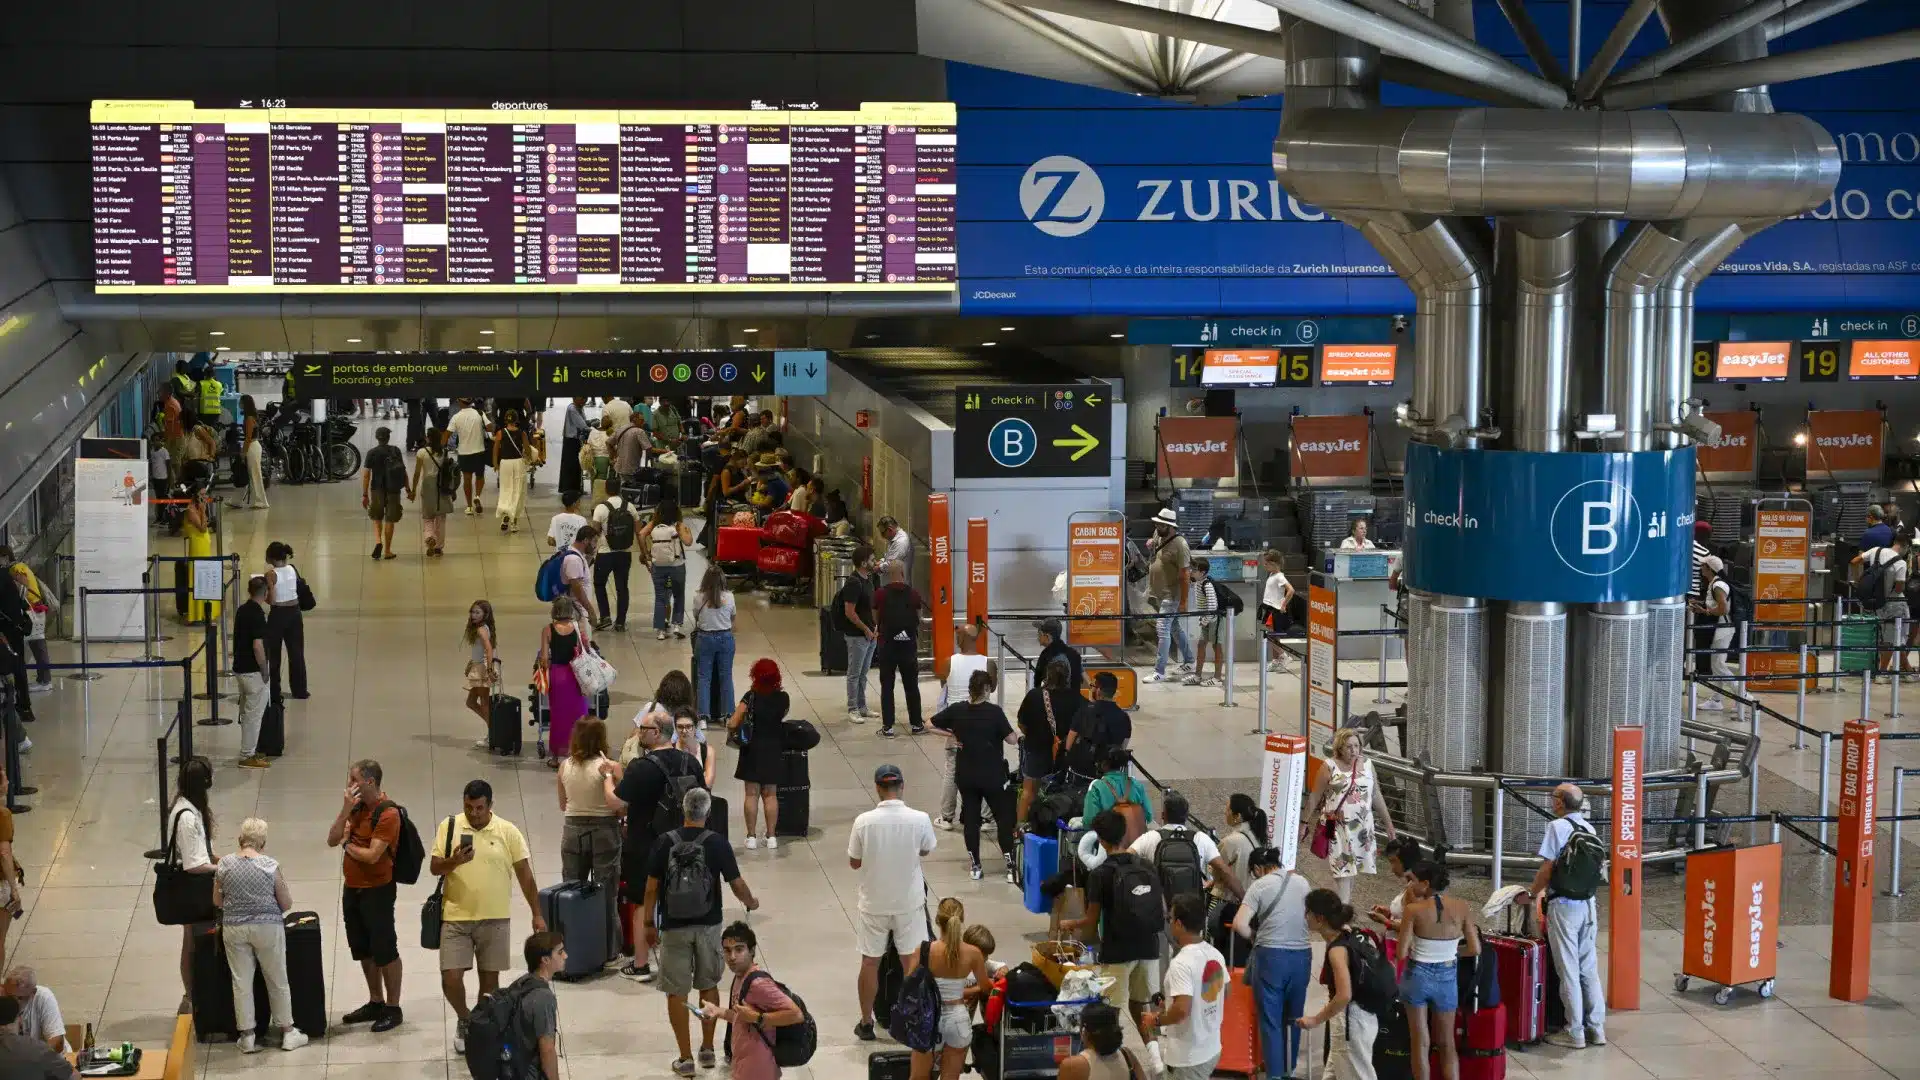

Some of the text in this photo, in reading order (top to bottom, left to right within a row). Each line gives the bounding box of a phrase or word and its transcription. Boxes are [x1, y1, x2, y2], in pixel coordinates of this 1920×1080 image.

[261, 99, 286, 108] 16:23
[492, 101, 548, 110] departures
[1136, 179, 1338, 221] ZURIC
[1024, 264, 1048, 275] Esta
[1050, 264, 1122, 277] comunicação
[1124, 264, 1131, 275] é
[1134, 265, 1148, 275] da
[1150, 264, 1182, 274] inteira
[1185, 263, 1274, 275] responsabilidade
[1277, 264, 1291, 274] da
[1293, 263, 1327, 274] Zurich
[1331, 263, 1385, 273] Insurance
[1718, 262, 1761, 273] Seguros
[1763, 261, 1791, 272] Vida,
[1819, 262, 1870, 273] registadas
[1887, 262, 1909, 271] ASF
[972, 290, 1017, 299] JCDecaux
[1231, 325, 1267, 336] check
[1271, 326, 1282, 336] in
[1840, 320, 1875, 331] check
[1878, 320, 1888, 331] in
[1722, 352, 1785, 367] easyJet
[1803, 350, 1836, 376] 19
[333, 363, 499, 375] portas de embarque terminal 1
[580, 368, 614, 378] check
[616, 368, 627, 378] in
[1279, 355, 1309, 380] 15
[1327, 368, 1390, 377] easyJet plus
[333, 375, 414, 386] boarding gates
[991, 395, 1022, 405] check
[1025, 395, 1035, 405] in
[1004, 429, 1023, 457] B
[1166, 440, 1228, 454] easyJet
[1300, 438, 1361, 453] easyJet
[1816, 434, 1873, 448] easyJet
[1424, 511, 1478, 529] check in
[1074, 527, 1118, 537] CABIN BAGS
[1582, 501, 1618, 555] B
[972, 561, 985, 583] EXIT
[1310, 600, 1335, 615] easyJet
[1844, 738, 1861, 796] BAG DROP
[1866, 738, 1876, 781] BAGAGEM
[1271, 758, 1281, 812] ASSISTANCE
[1866, 781, 1874, 794] DE
[1621, 749, 1636, 841] SPEEDY BOARDING
[1864, 794, 1873, 835] ENTREGA
[1703, 878, 1717, 966] easyJet
[1748, 880, 1763, 968] easyJet
